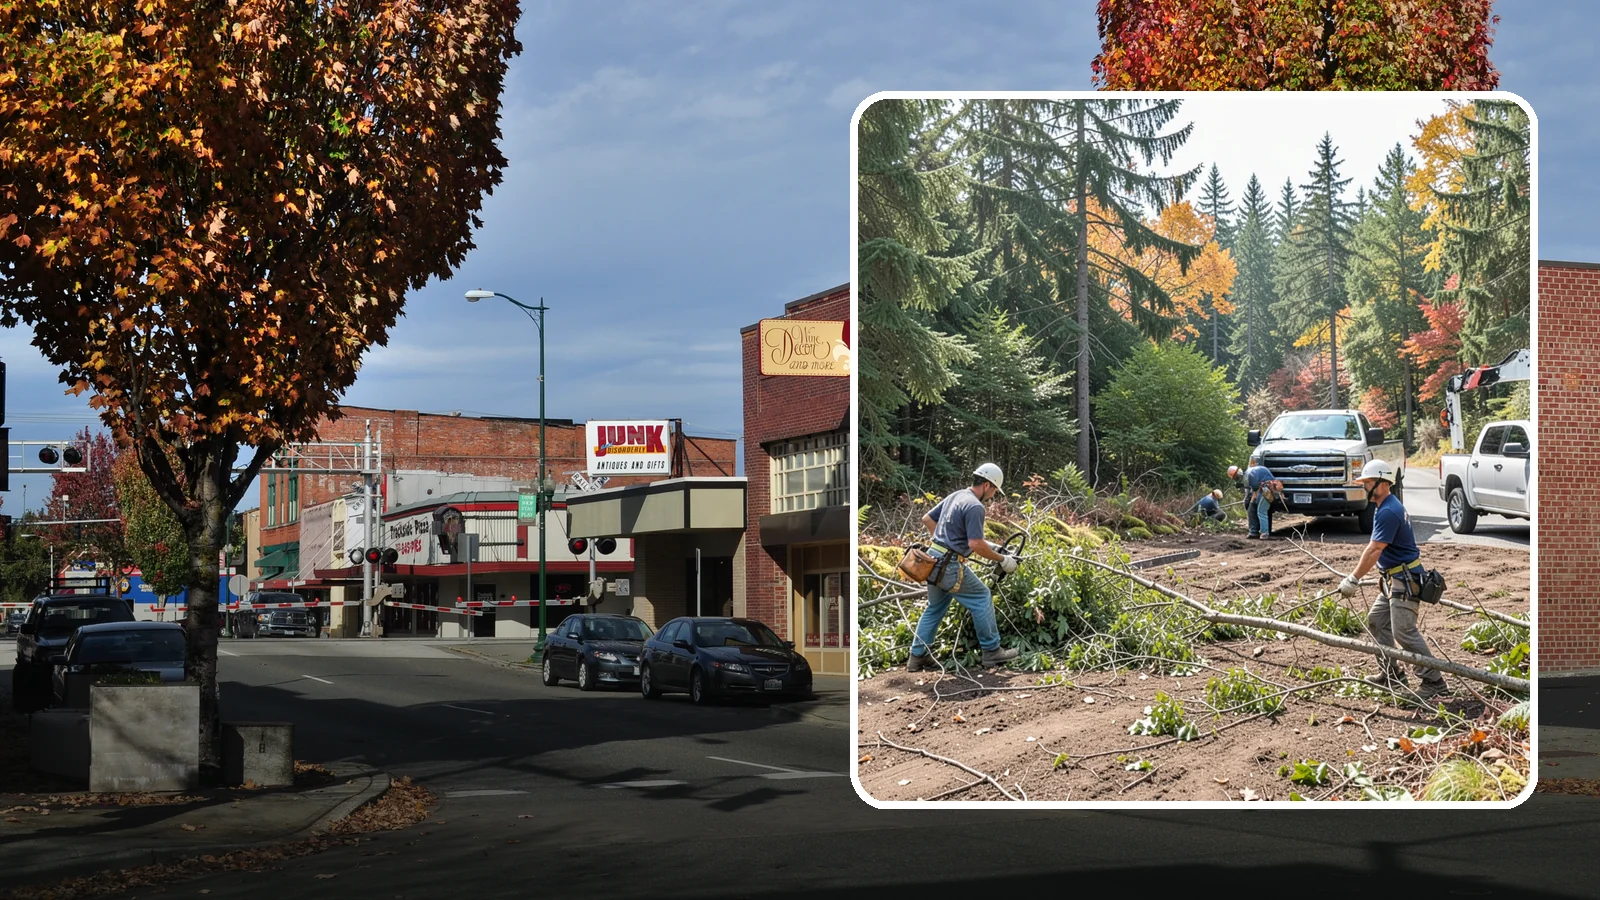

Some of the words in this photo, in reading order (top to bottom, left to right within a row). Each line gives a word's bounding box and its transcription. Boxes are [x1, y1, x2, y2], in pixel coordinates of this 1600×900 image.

[595, 425, 665, 457] JUNK
[607, 446, 645, 454] DISORDERLY
[597, 461, 628, 470] ANTIQUES
[631, 461, 643, 470] AND
[647, 460, 665, 469] GIFTS
[352, 498, 364, 511] CRO
[414, 519, 429, 534] Pizza
